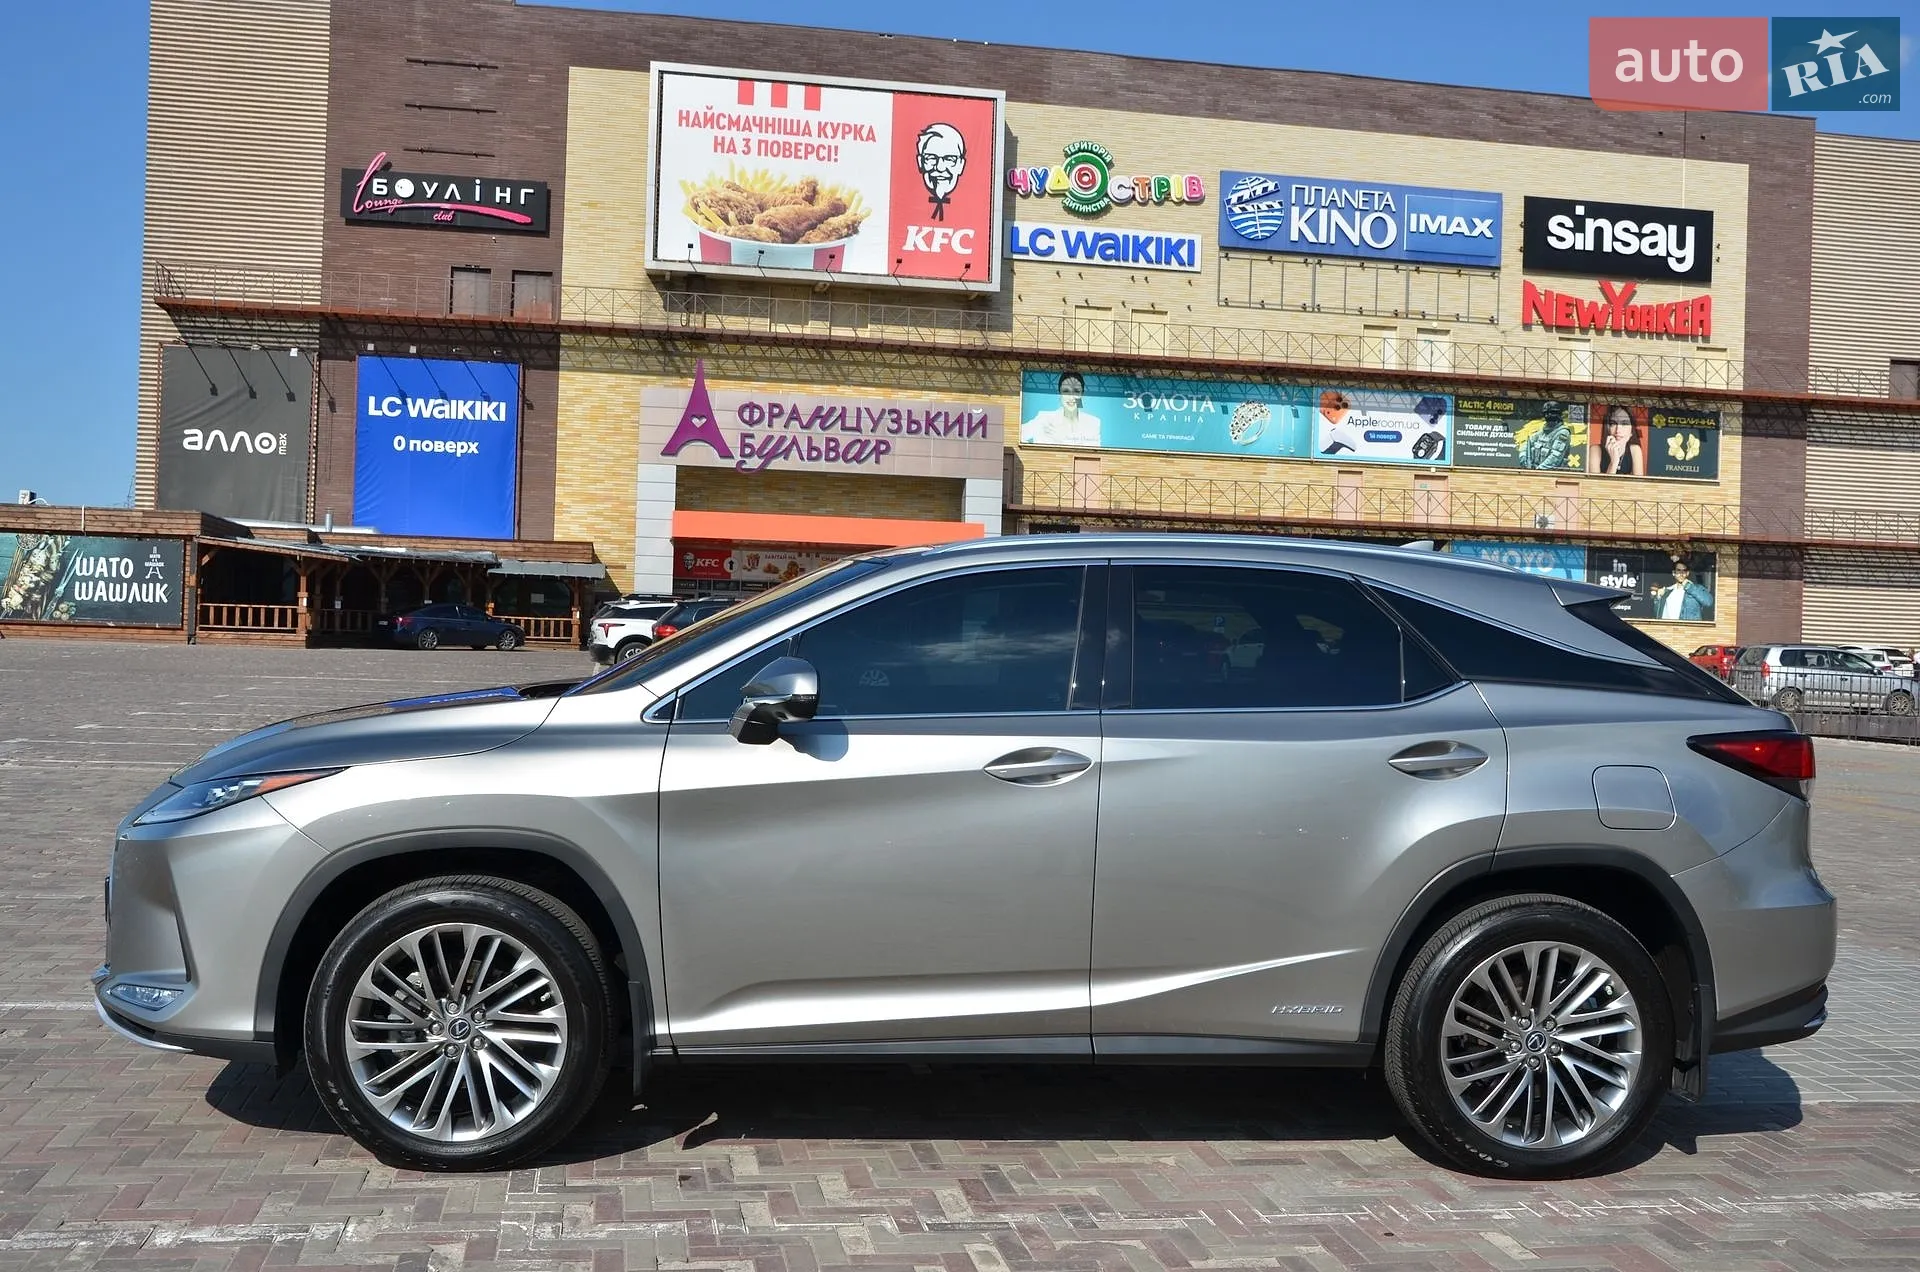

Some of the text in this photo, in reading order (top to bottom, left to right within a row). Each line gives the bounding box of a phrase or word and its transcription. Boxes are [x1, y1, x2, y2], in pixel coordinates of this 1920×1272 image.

[678, 105, 877, 143] НАЙСМАЧНІША КУРКА
[713, 135, 839, 163] НА 3 ПОВЕРСІ!
[1064, 140, 1113, 163] ТЕРИТОРІЯ
[1063, 196, 1111, 213] ДИТИНСТВА
[1291, 184, 1397, 213] ПЛАНЕТА
[1290, 205, 1398, 250] KINO
[1409, 213, 1494, 239] IMAX
[902, 225, 976, 255] KFC
[1011, 226, 1056, 258] LC
[1547, 205, 1696, 274] sinsay
[368, 396, 403, 417] LC
[1123, 391, 1216, 414] ЗОЛОТА
[1458, 400, 1485, 410] TACTIC
[1486, 400, 1492, 410] 4
[737, 401, 988, 439] ФРАНЦУЗЬКИЙ
[279, 432, 287, 456] max
[394, 435, 480, 457] 0 поверх
[76, 556, 134, 579] ШАТО
[696, 558, 720, 568] KFC
[1613, 558, 1628, 573] in
[74, 580, 169, 604] ШАШЛИК
[1600, 573, 1637, 589] style
